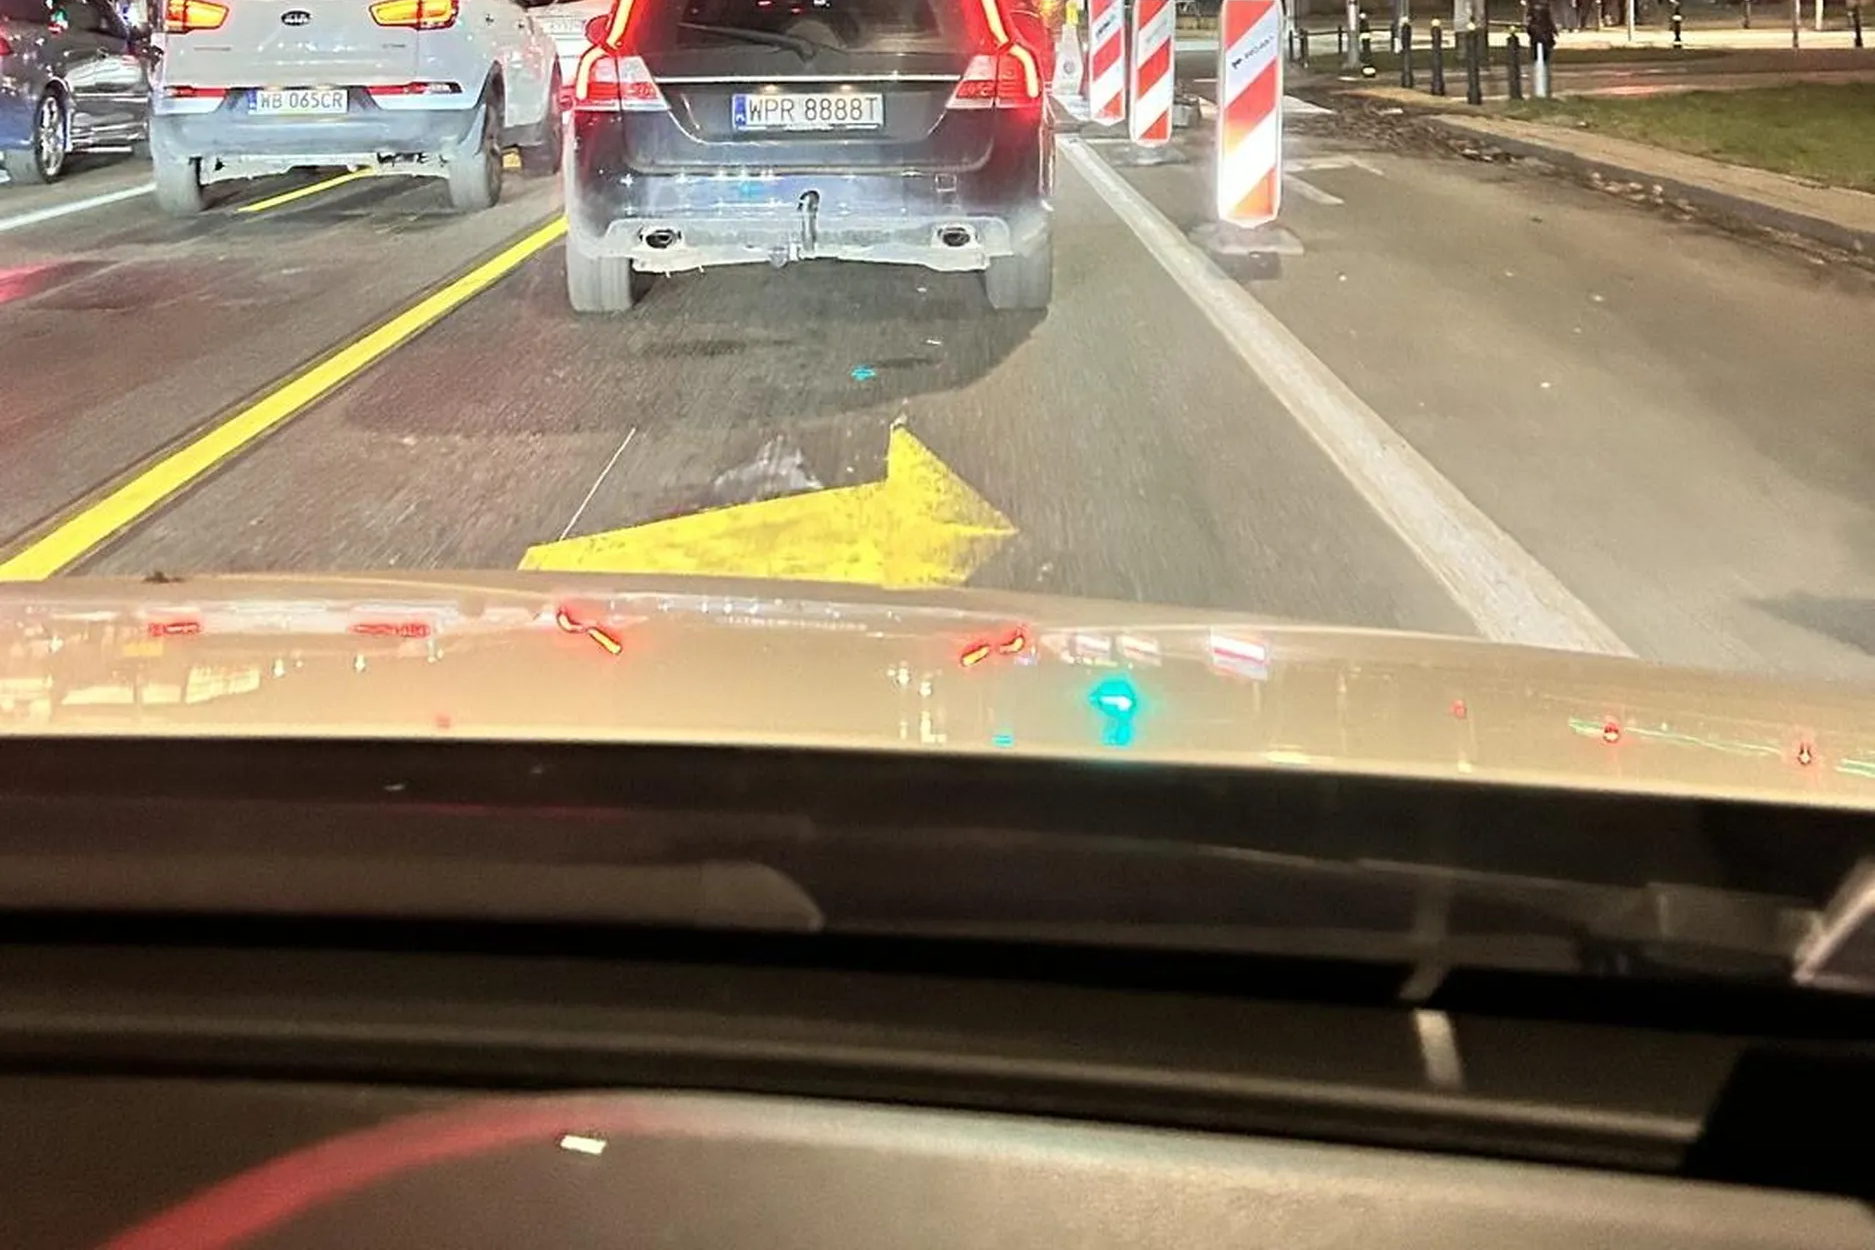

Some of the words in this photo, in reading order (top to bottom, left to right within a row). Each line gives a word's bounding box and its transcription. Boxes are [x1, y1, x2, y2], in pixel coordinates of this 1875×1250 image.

[260, 92, 282, 109] WB
[289, 92, 343, 109] 065CR
[749, 98, 795, 122] WPR
[804, 97, 878, 122] 8888T
